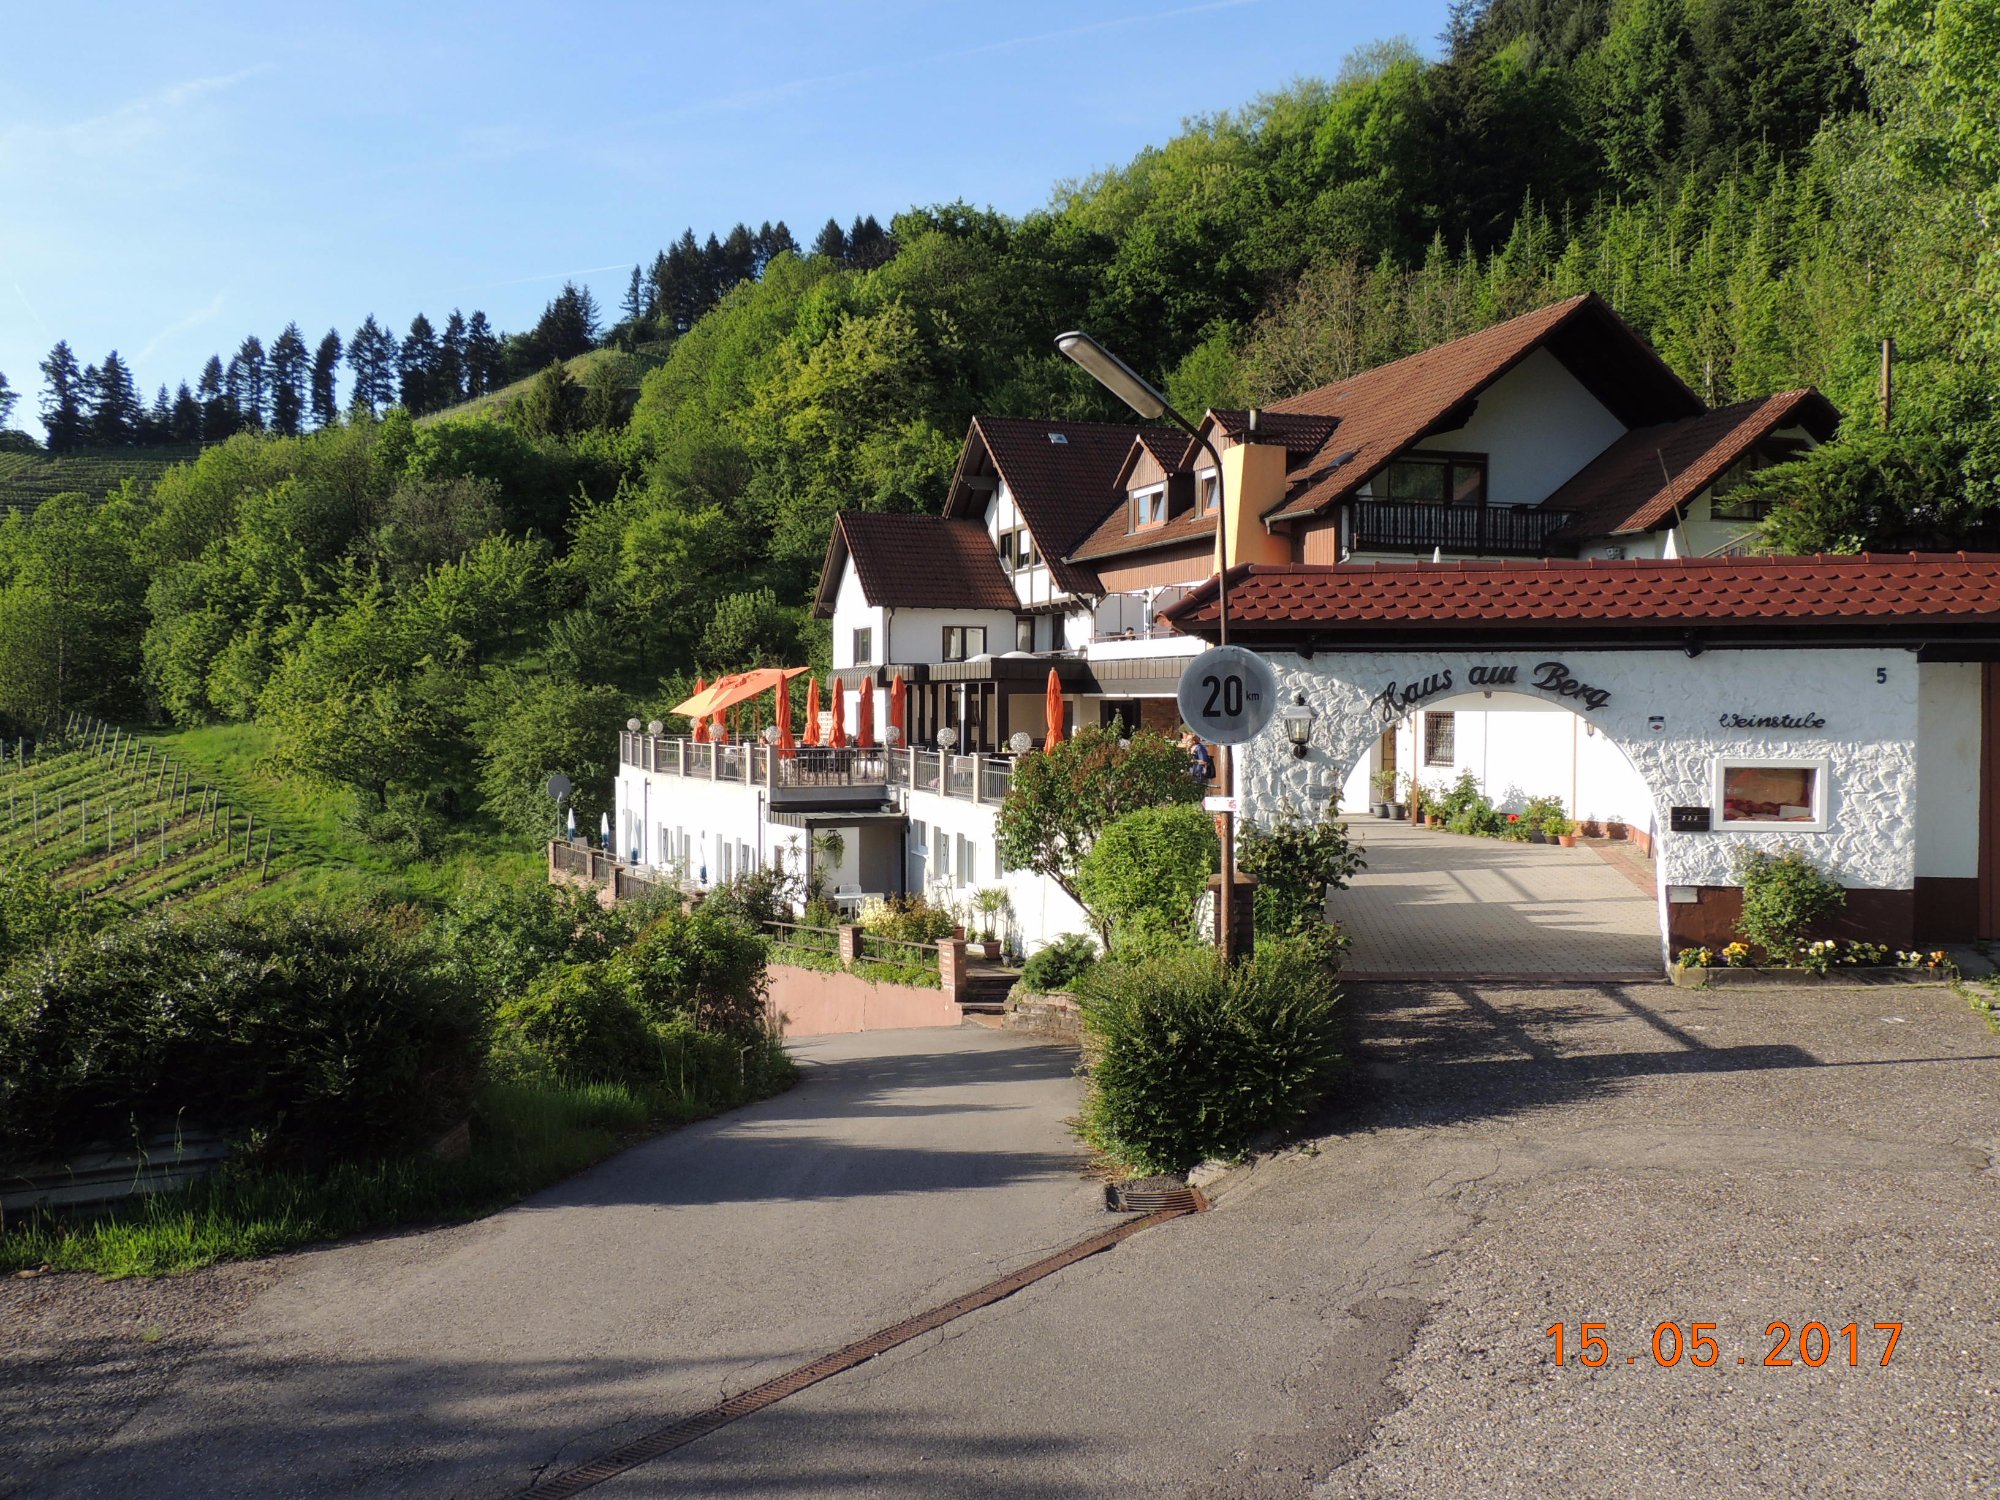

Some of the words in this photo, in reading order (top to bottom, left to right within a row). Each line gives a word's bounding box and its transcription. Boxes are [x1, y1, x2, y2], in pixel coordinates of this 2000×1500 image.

[1876, 667, 1887, 684] 5
[1202, 675, 1243, 718] 20
[1246, 690, 1260, 701] km
[1369, 669, 1453, 723] Haus
[1530, 661, 1612, 711] Berg
[1718, 712, 1827, 729] Weinstube
